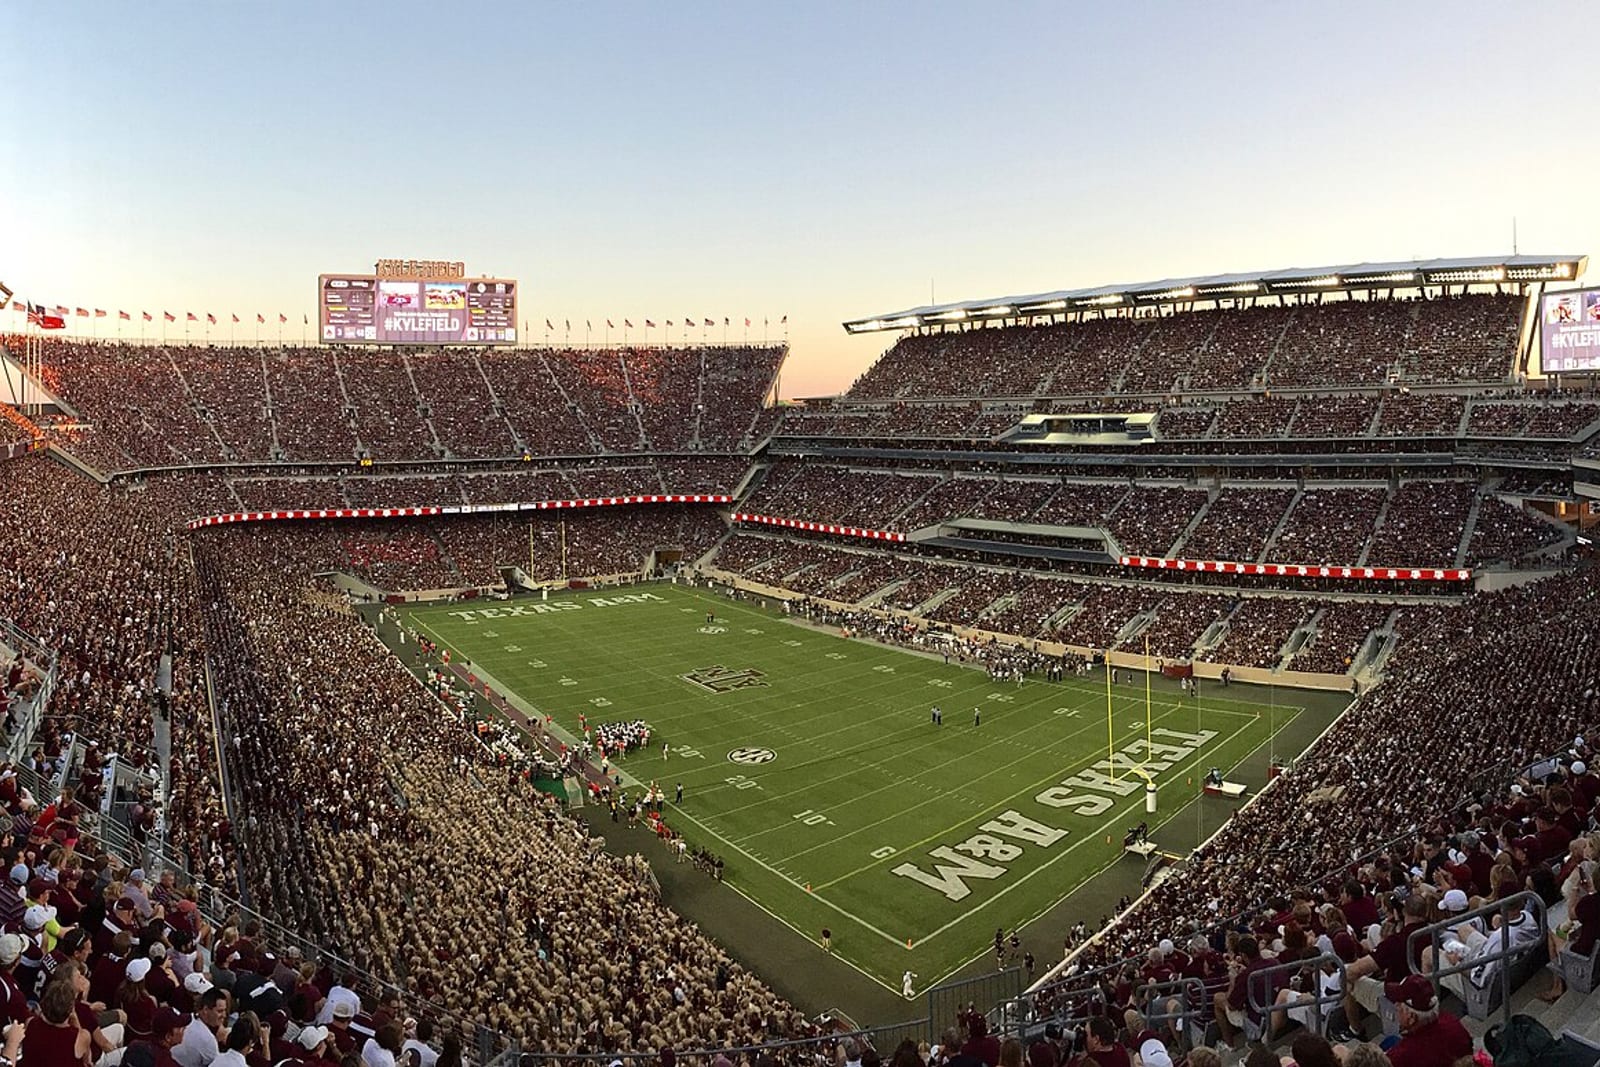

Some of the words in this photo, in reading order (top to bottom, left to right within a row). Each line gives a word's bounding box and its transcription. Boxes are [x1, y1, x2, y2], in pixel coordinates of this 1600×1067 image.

[384, 317, 460, 332] #KYLEFIELD
[448, 601, 583, 621] TEXAS
[1034, 728, 1220, 816] TEXAS
[793, 809, 827, 826] 10
[870, 846, 897, 859] G
[891, 809, 1070, 902] A&M
